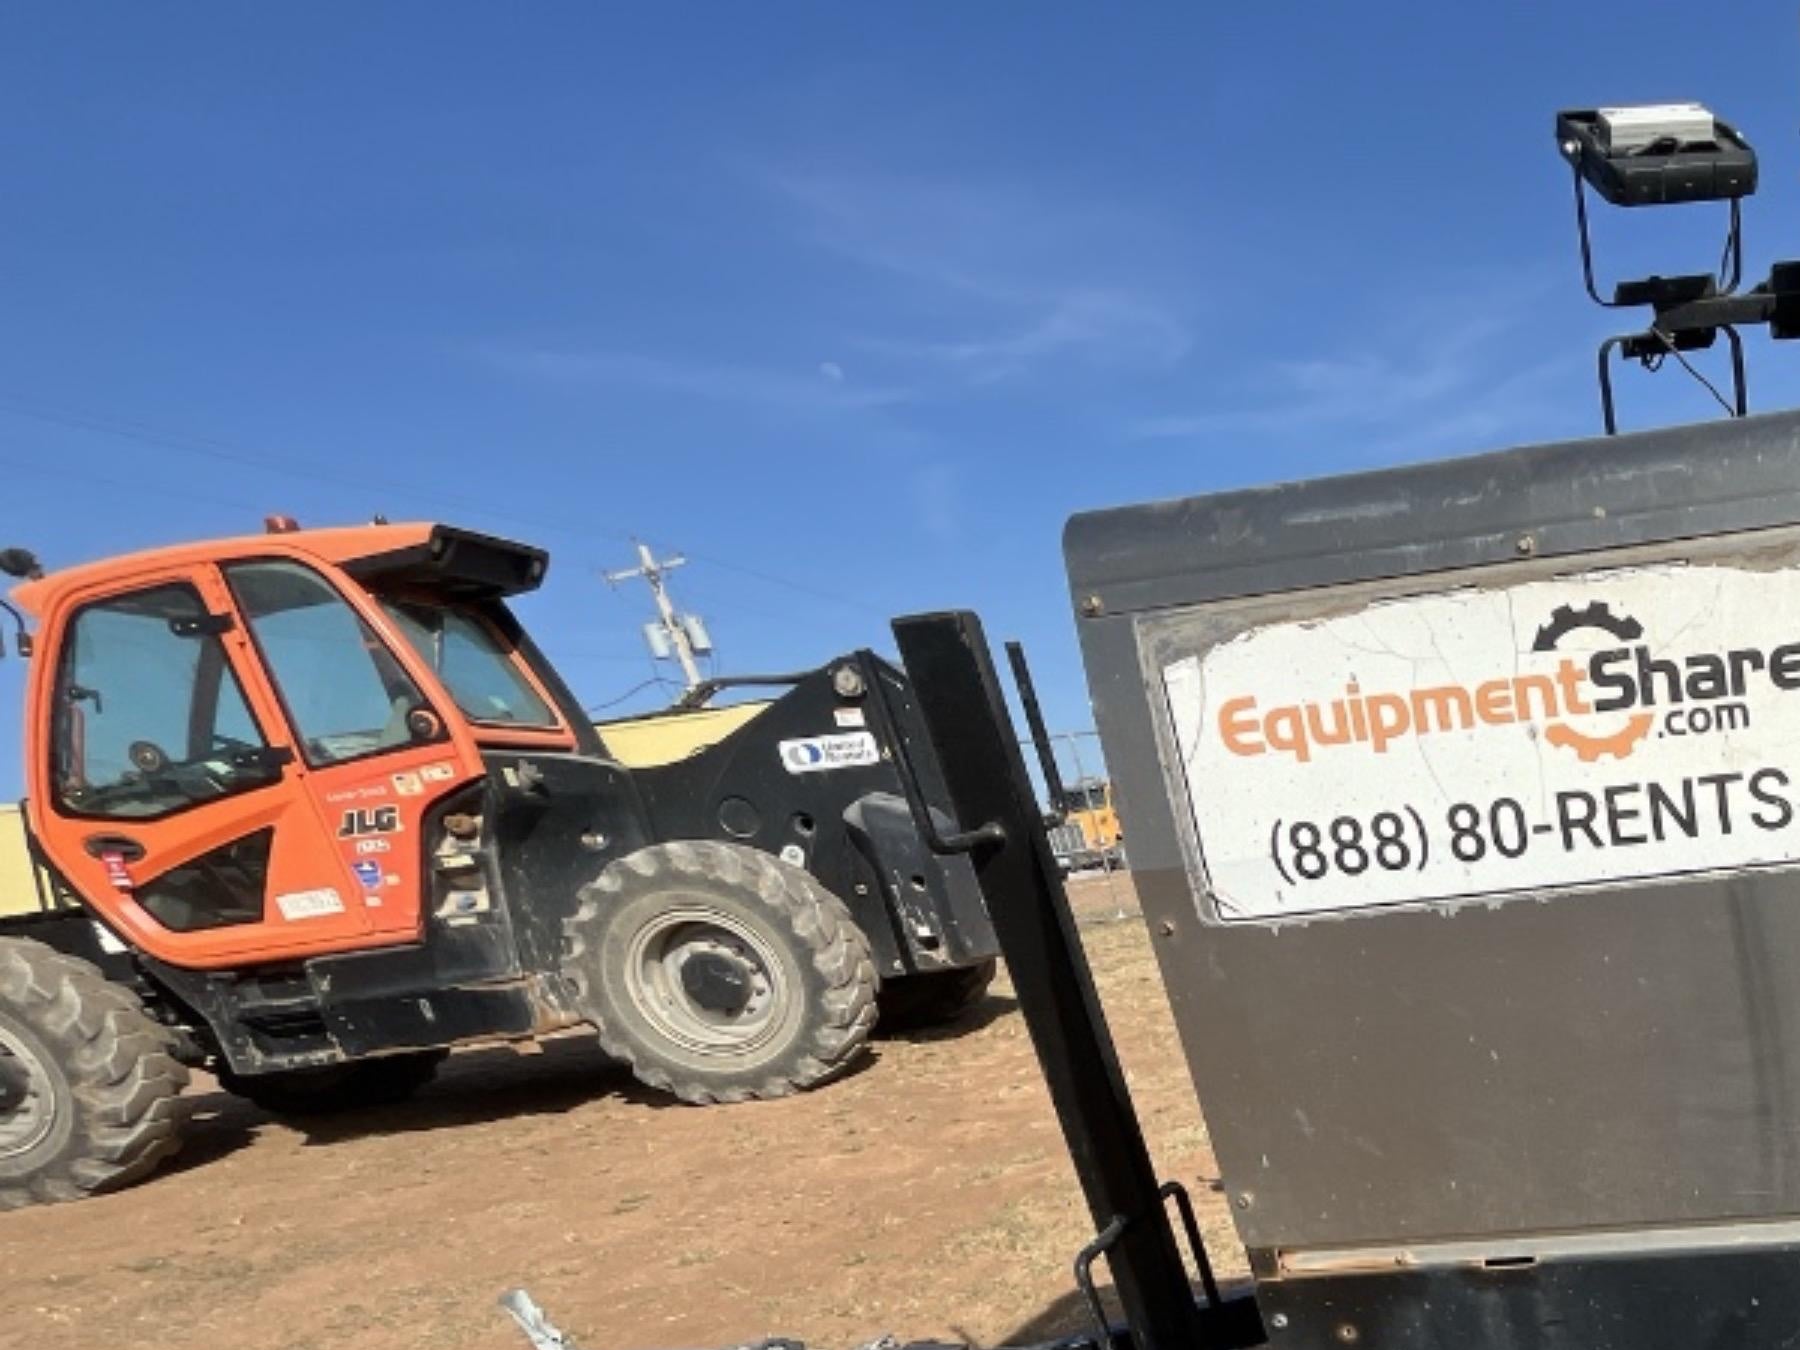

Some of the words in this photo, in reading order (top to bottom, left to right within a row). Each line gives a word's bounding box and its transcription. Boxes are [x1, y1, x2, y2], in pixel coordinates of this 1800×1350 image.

[1658, 702, 1750, 739] .com
[337, 804, 400, 840] JLG
[1270, 805, 1430, 886] (888)
[1446, 768, 1794, 865] 80-RENTS
